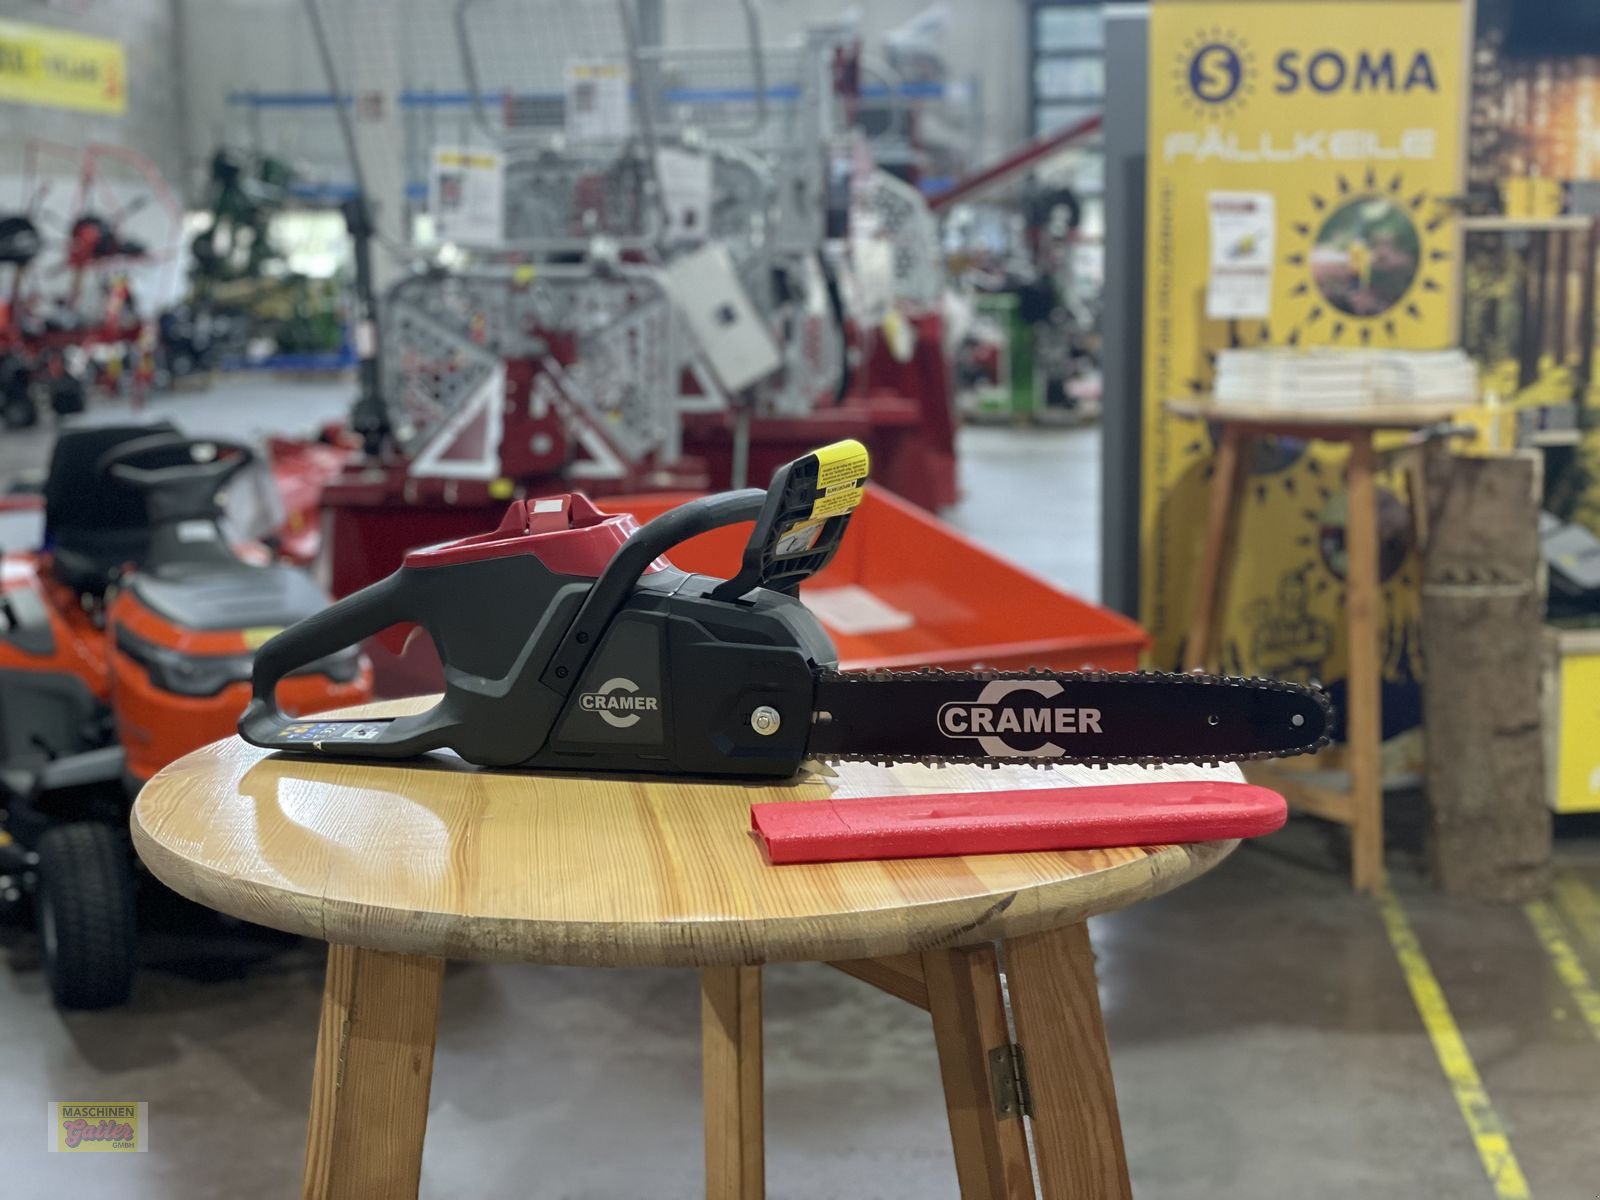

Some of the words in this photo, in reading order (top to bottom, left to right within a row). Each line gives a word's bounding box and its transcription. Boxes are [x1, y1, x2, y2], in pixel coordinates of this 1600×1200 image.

[1274, 50, 1438, 94] SOMA
[582, 695, 658, 710] CRAMER
[944, 707, 1103, 734] CRAMER
